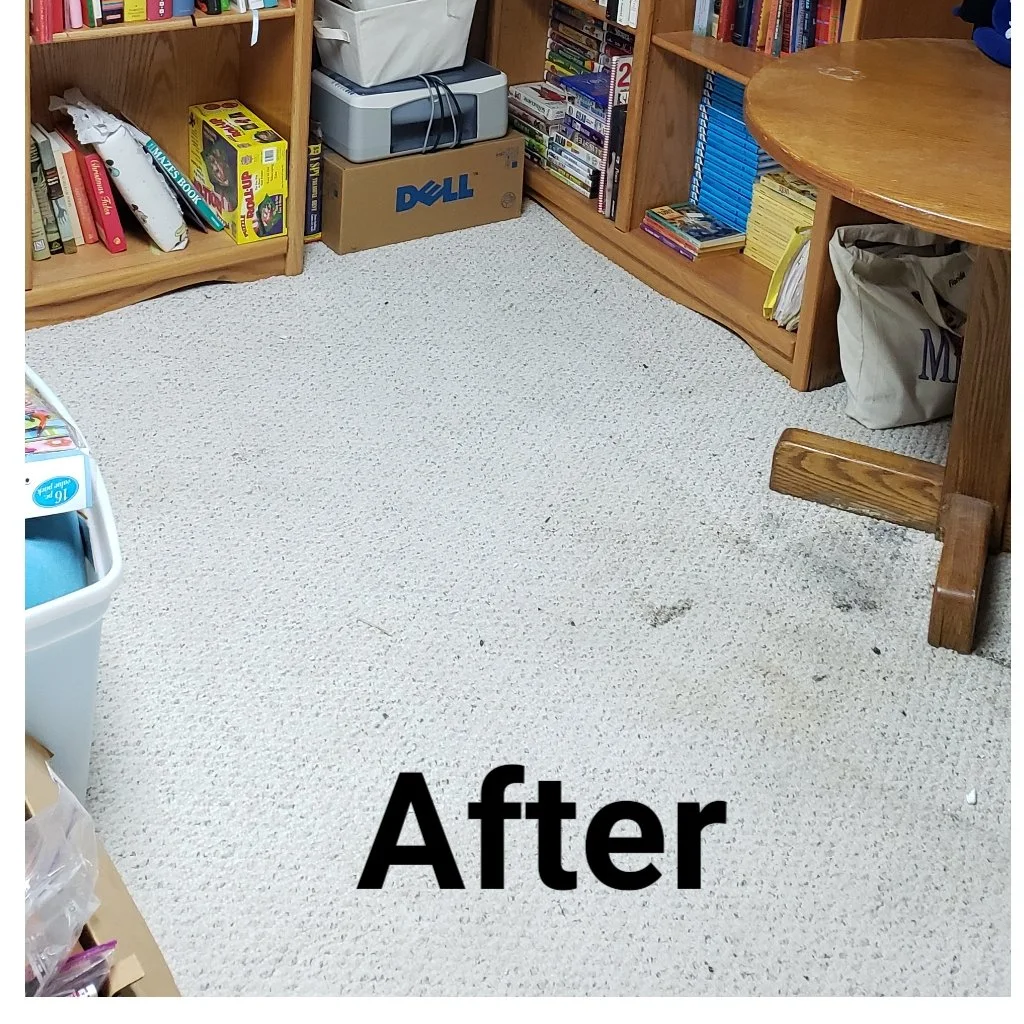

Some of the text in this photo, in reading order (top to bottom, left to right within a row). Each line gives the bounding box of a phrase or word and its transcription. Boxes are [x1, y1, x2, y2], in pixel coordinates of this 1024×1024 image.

[89, 158, 111, 216] Christmas Tales
[152, 146, 201, 204] MAZES BOOK
[396, 173, 474, 213] DELL
